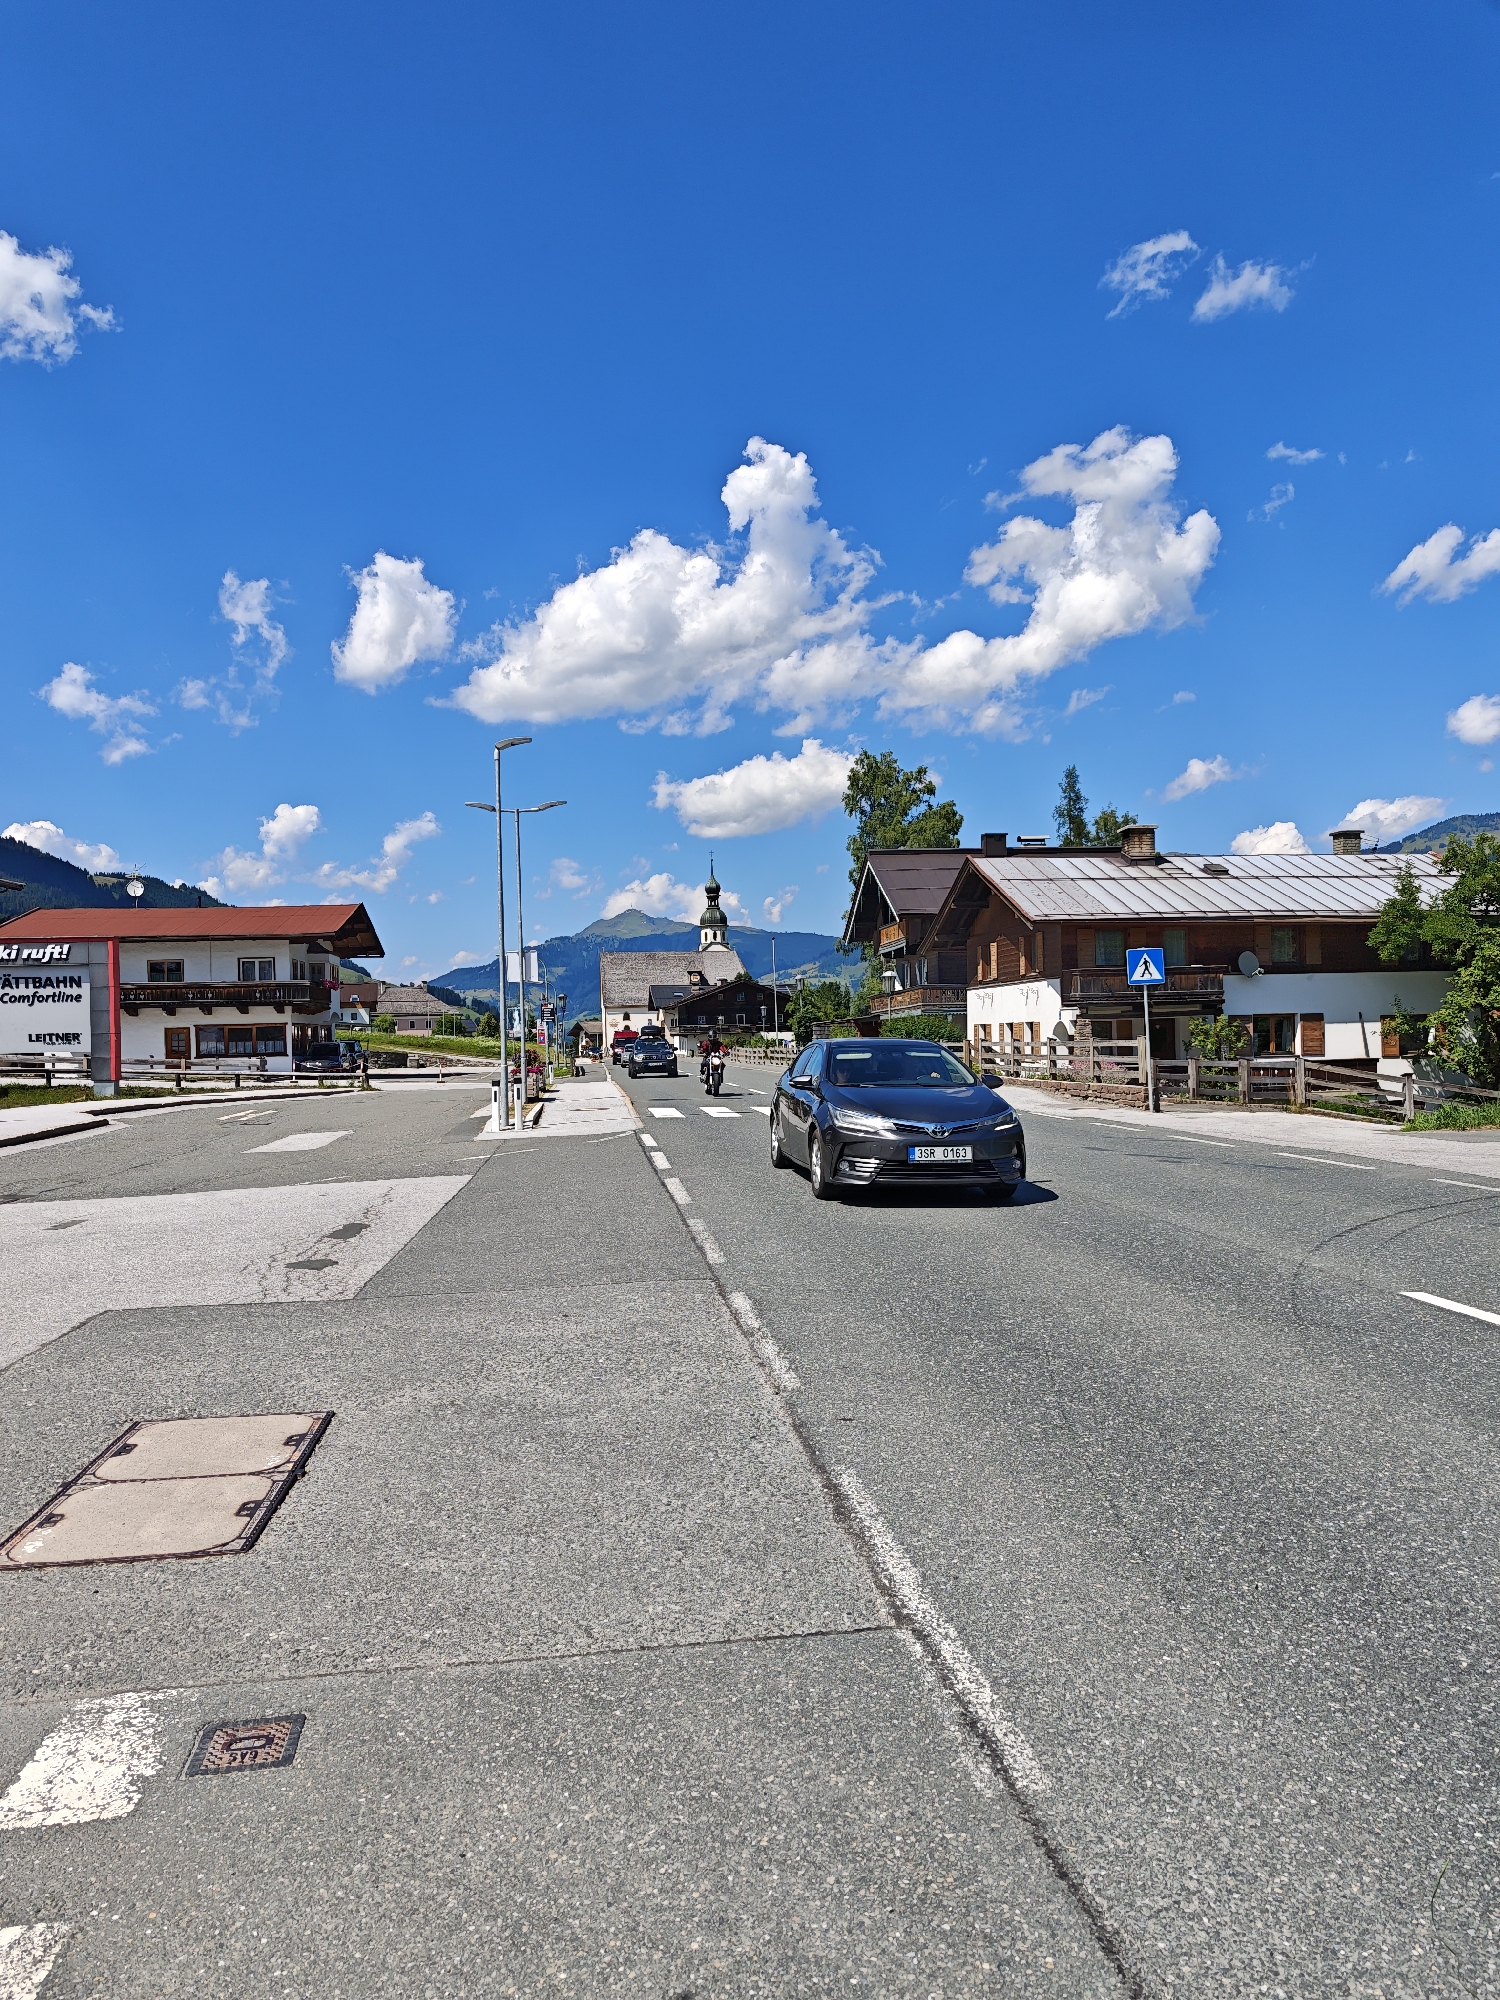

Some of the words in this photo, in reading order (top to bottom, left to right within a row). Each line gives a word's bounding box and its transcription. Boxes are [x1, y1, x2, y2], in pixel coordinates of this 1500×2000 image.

[22, 944, 70, 963] ruft!
[0, 973, 82, 990] ÄTTBAHN
[28, 1032, 82, 1043] LEITNER
[917, 1148, 936, 1159] 3SR
[943, 1147, 967, 1159] 0163
[228, 1750, 259, 1765] GAS
